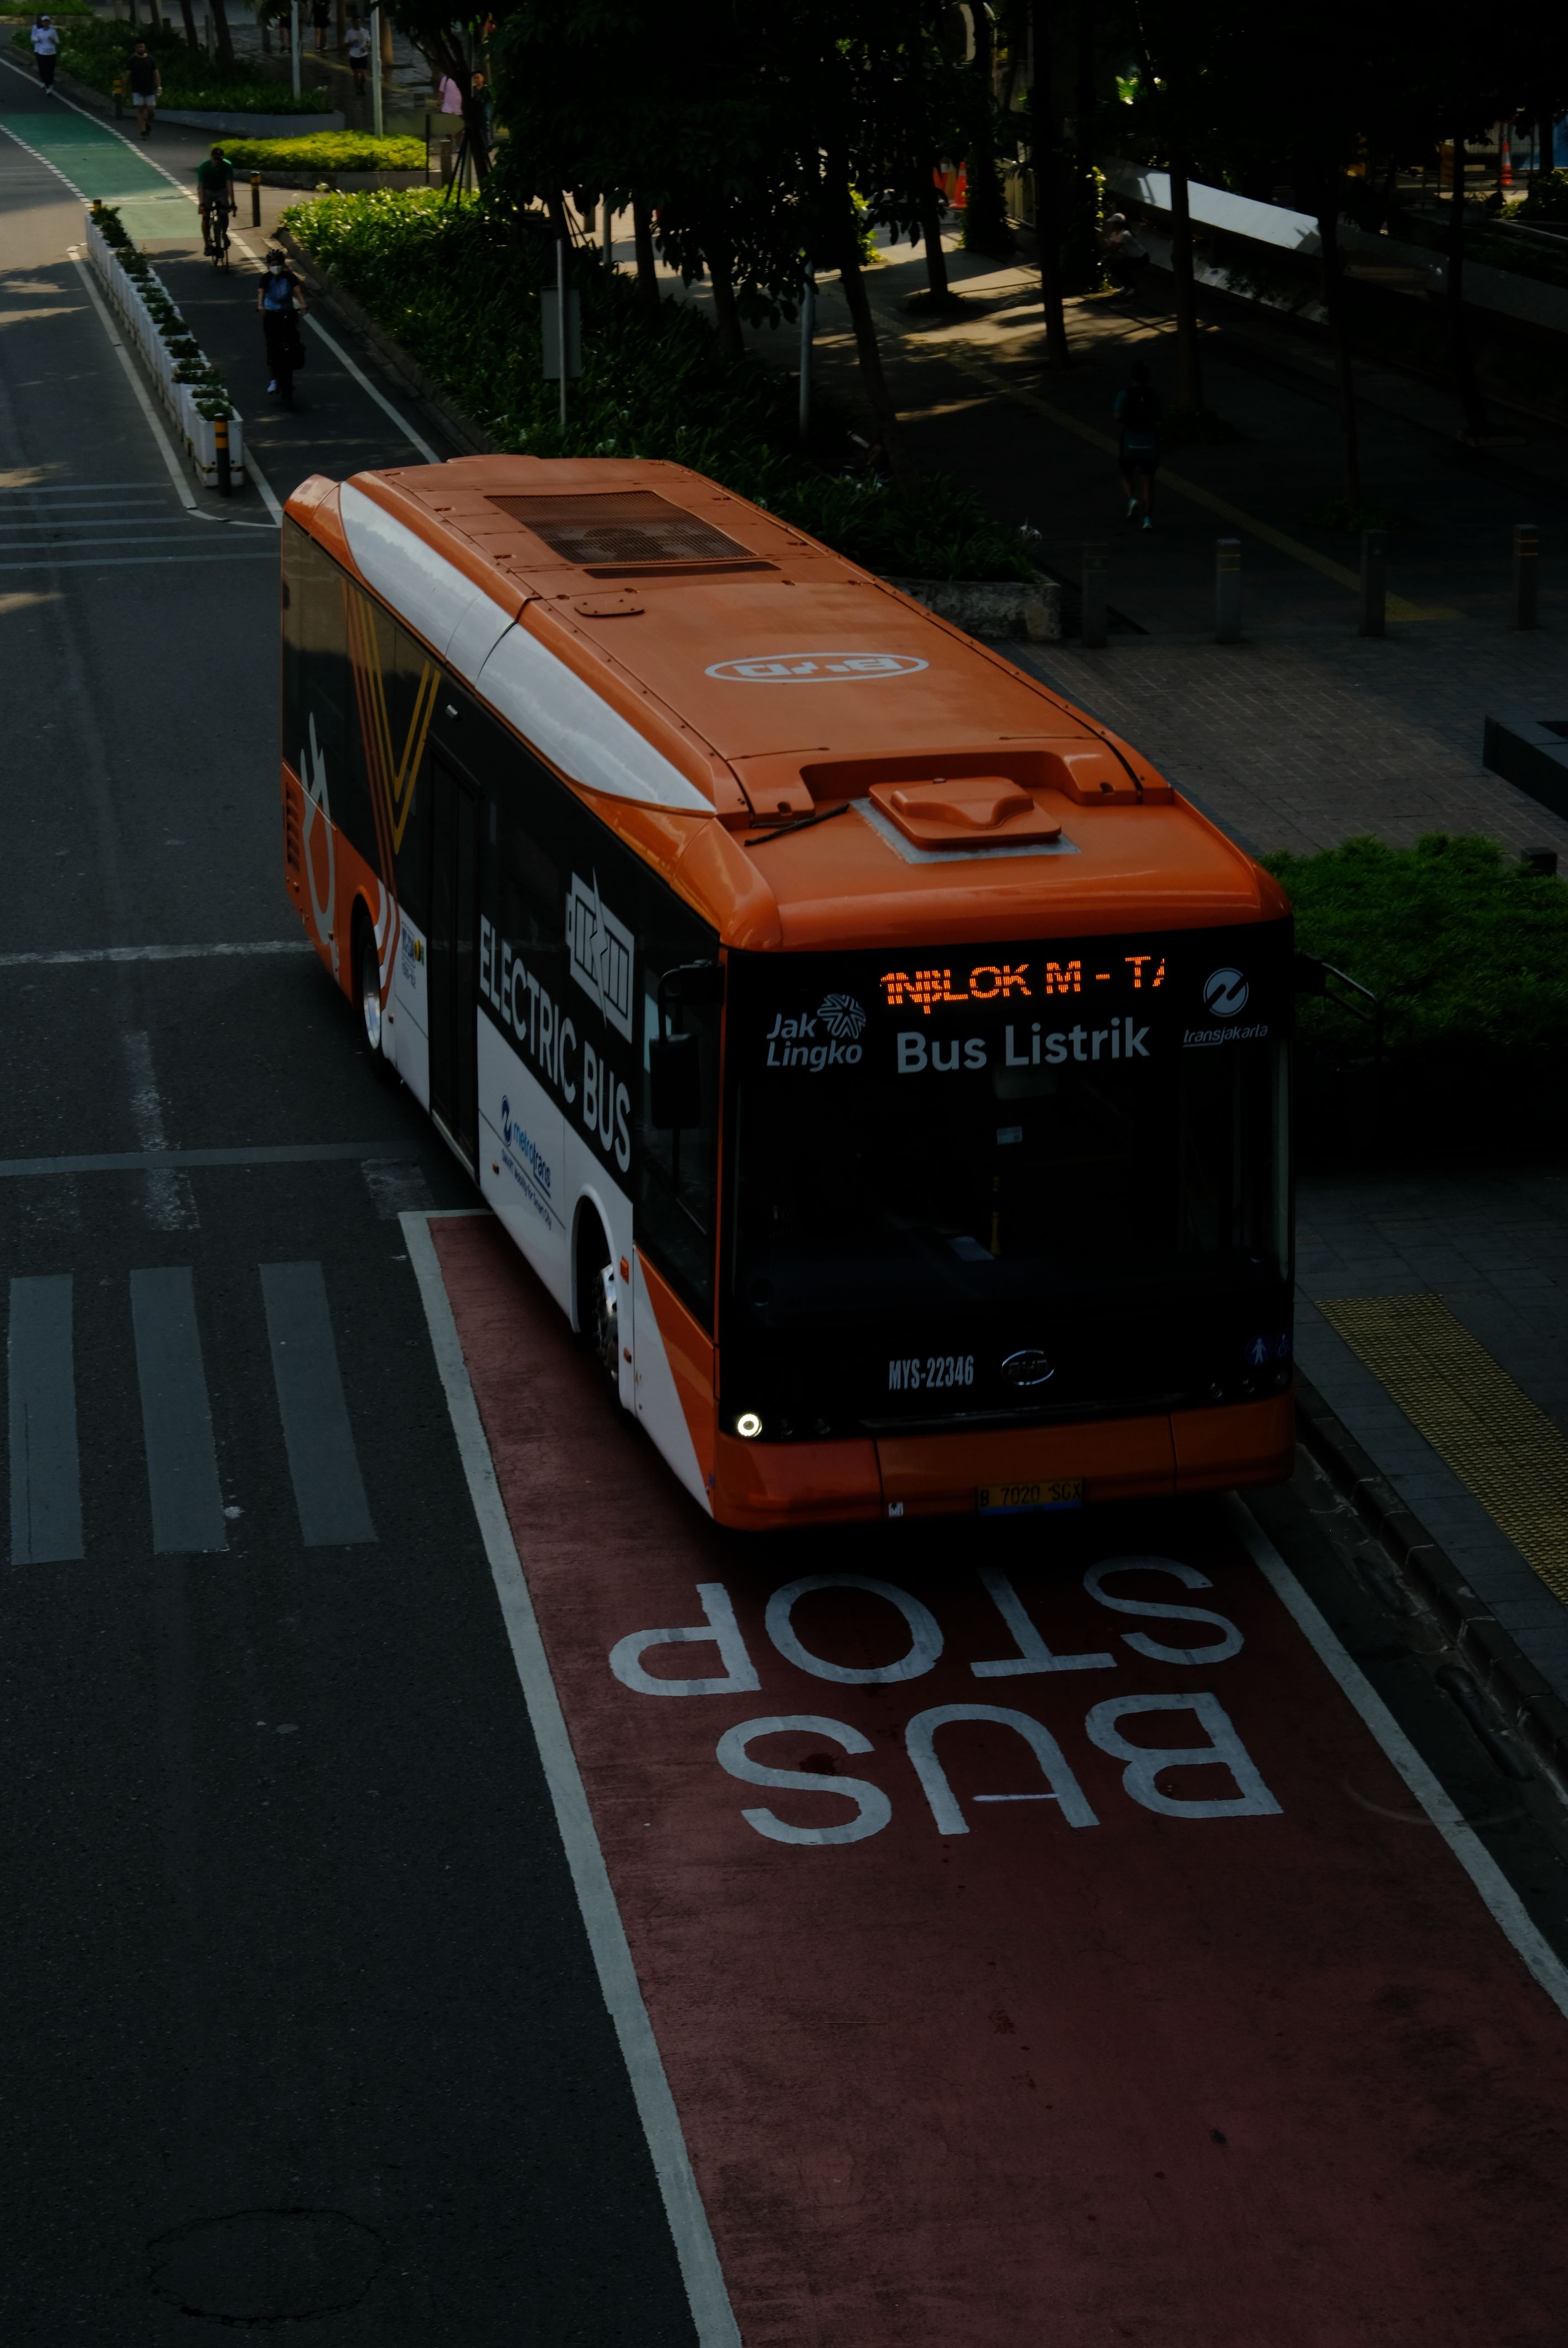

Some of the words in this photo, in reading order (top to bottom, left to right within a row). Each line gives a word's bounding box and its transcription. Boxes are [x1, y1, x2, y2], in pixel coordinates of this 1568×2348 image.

[1046, 960, 1081, 995] M
[479, 912, 577, 1105] ELECTRIC
[582, 1038, 631, 1174] BUS
[766, 1011, 818, 1039] Jak
[1182, 1023, 1268, 1048] transjakarta
[766, 1038, 863, 1073] Lingko
[896, 1030, 988, 1074] Bus
[1004, 1016, 1151, 1067] Listrik
[513, 1121, 551, 1196] metrotrans
[888, 1353, 974, 1391] MYS-22346
[979, 1489, 990, 1507] B
[1000, 1484, 1040, 1505] 7020
[608, 1555, 1245, 1697] STOP
[715, 1691, 1284, 1845] BUS
